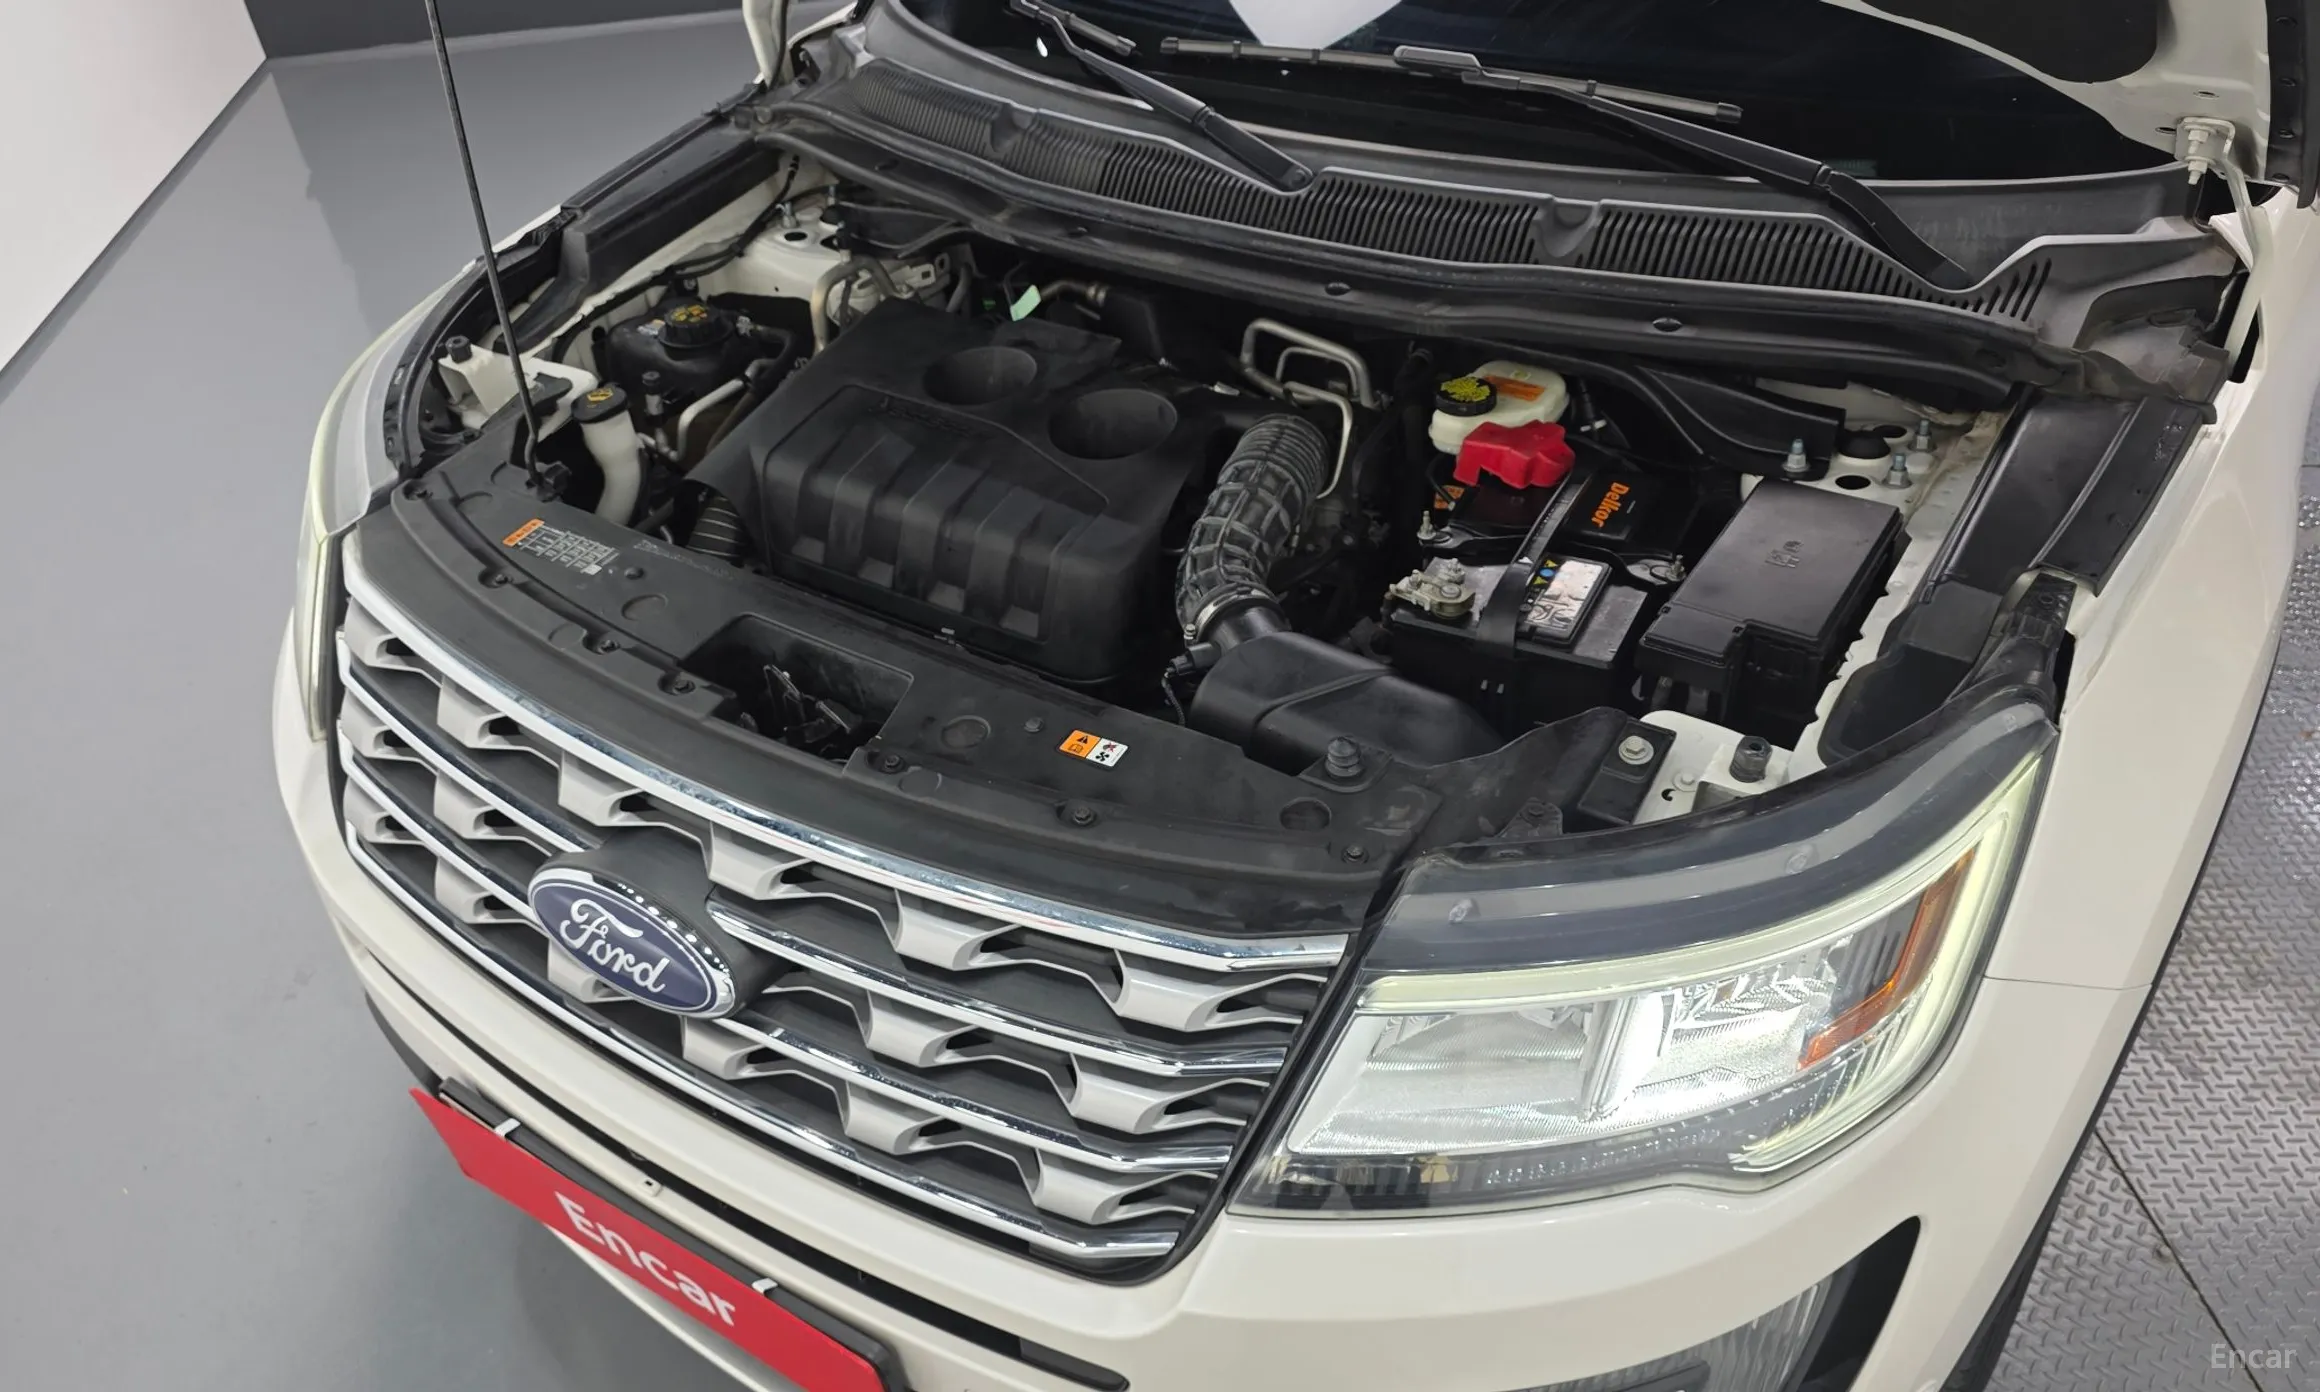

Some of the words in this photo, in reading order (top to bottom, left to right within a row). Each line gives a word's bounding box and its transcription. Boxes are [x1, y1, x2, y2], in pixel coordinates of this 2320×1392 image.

[1591, 482, 1630, 528] Delkor
[559, 898, 669, 995] Ford
[554, 1190, 737, 1327] Encar
